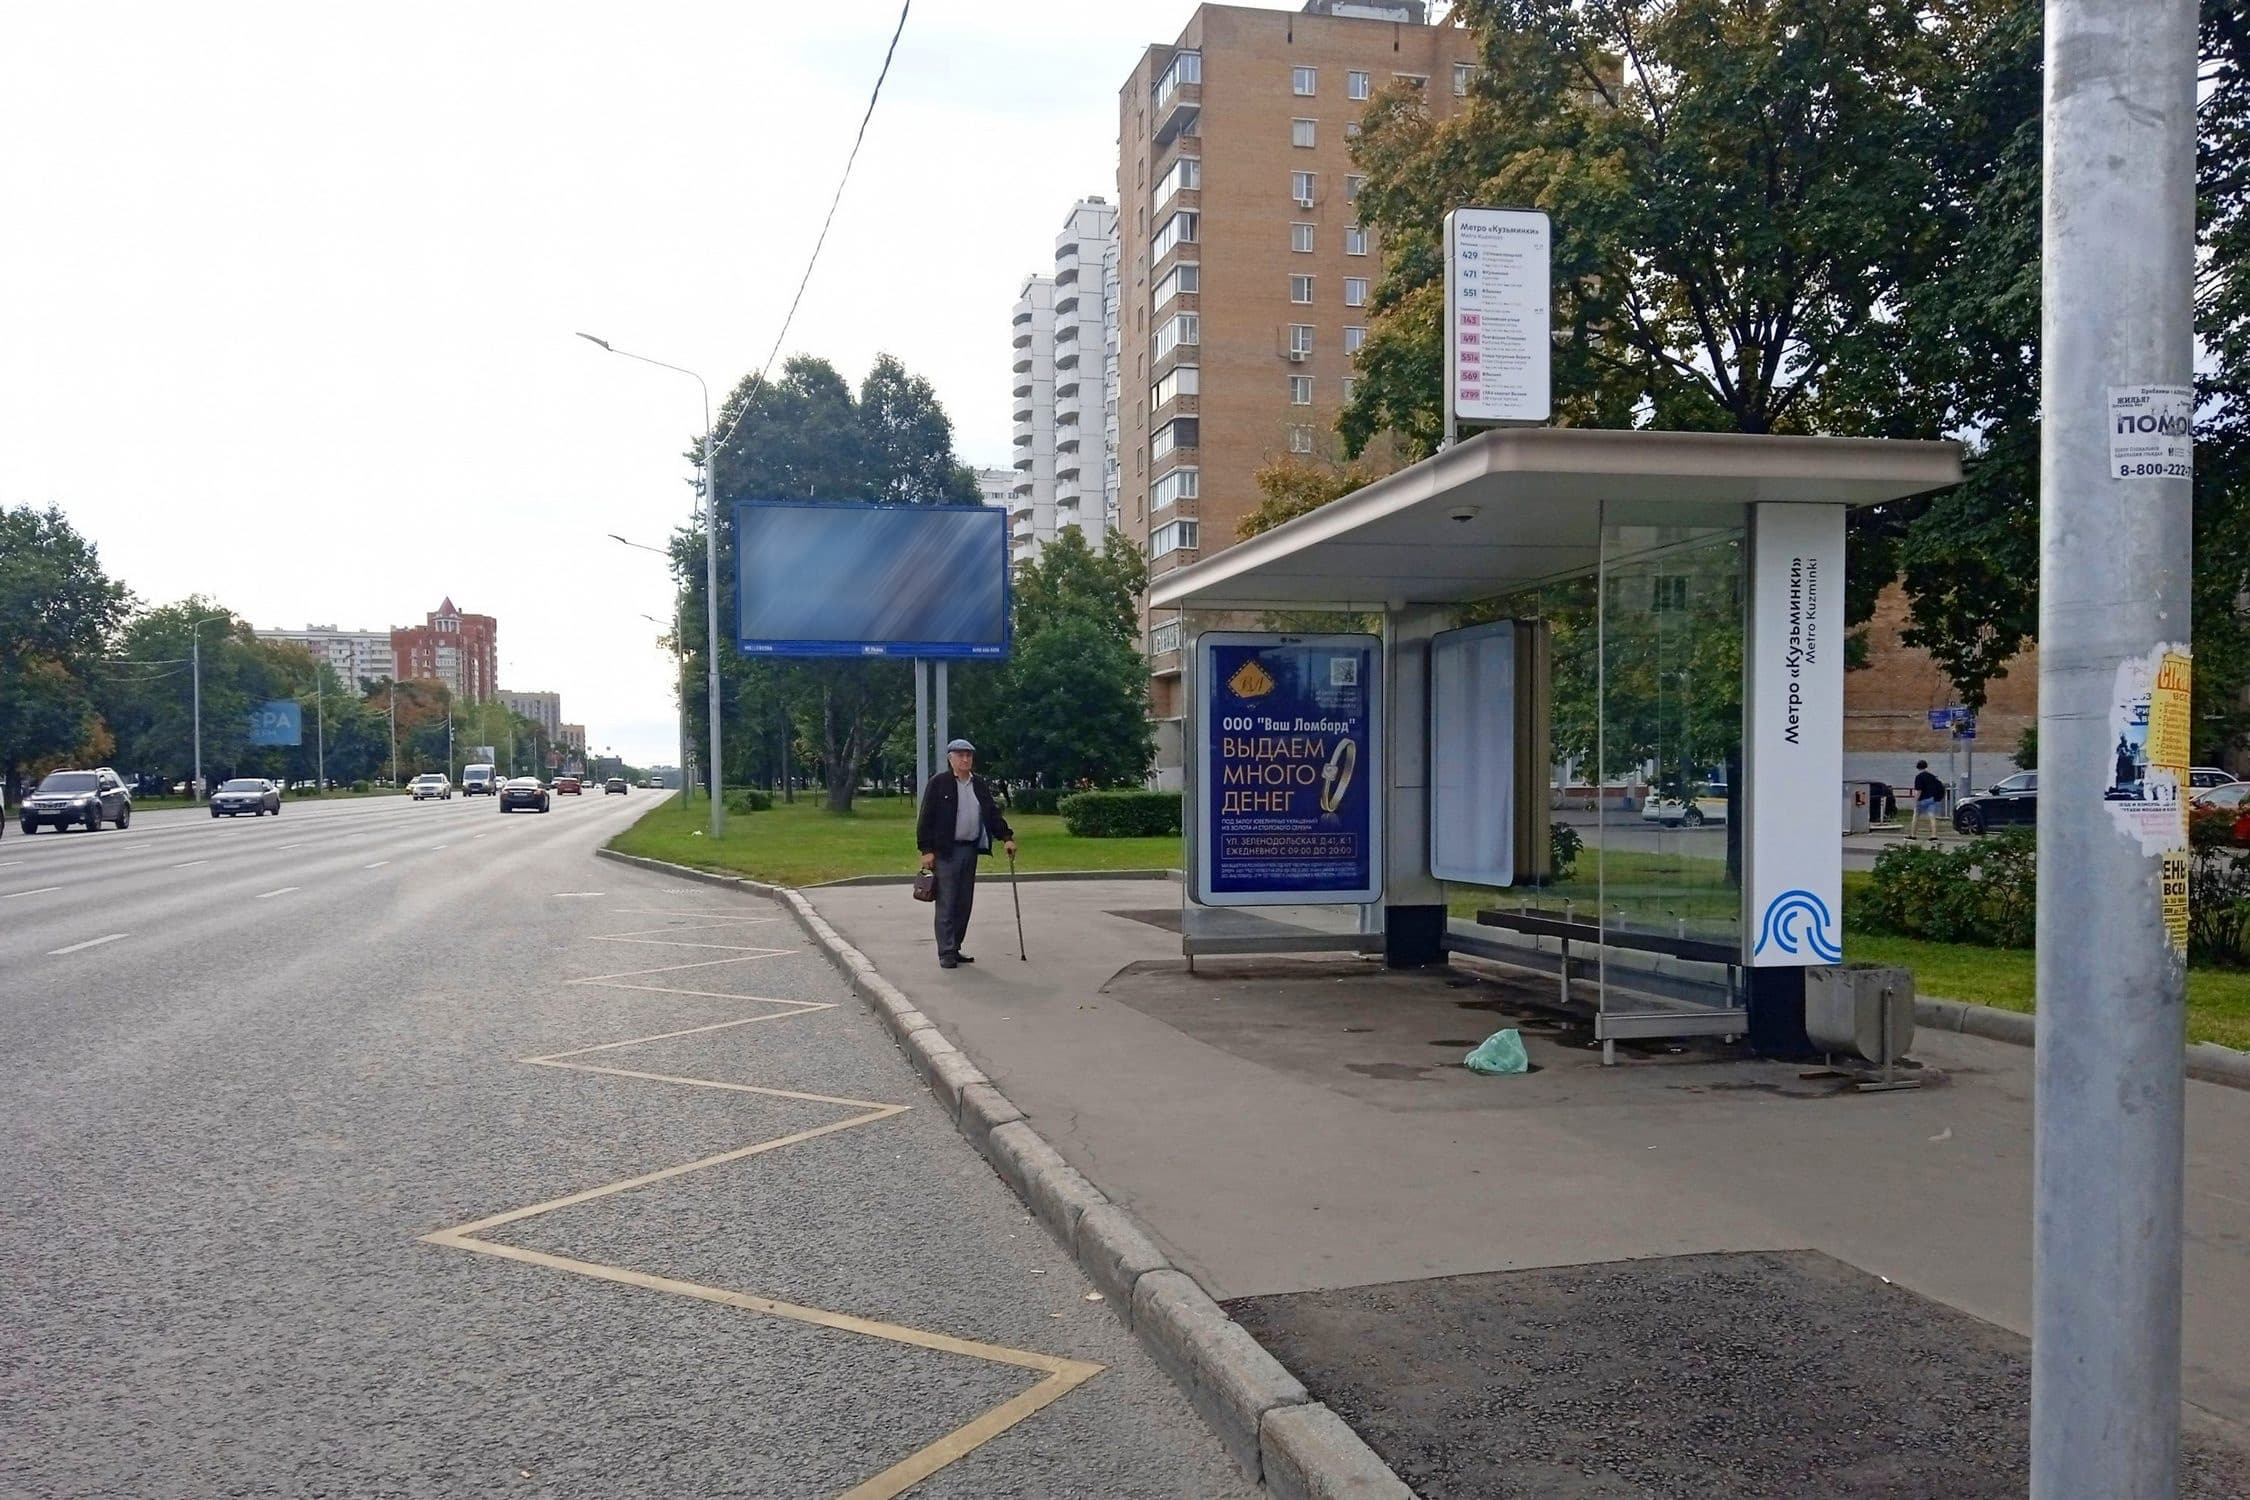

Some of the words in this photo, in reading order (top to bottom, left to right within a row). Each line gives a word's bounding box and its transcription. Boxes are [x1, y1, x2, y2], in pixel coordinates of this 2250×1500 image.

[1460, 223, 1487, 232] Метро
[1462, 250, 1478, 260] 429
[1463, 269, 1477, 279] 471
[1463, 288, 1477, 297] 551
[1463, 316, 1477, 325] 143
[1463, 335, 1477, 343] 491
[1462, 371, 1478, 380] 569
[1806, 558, 1818, 620] Kuzminki
[1786, 557, 1804, 678] «Кузьминки»
[1806, 623, 1817, 665] Metro
[1785, 682, 1803, 744] Метро
[1223, 717, 1253, 731] ООО
[1257, 717, 1290, 731] "Ваш
[1293, 717, 1356, 735] Ломбард"
[1223, 737, 1325, 761] ВЫДАЕМ
[1223, 764, 1316, 785] МНОГО
[1221, 791, 1295, 815] ДЕНЕГ
[1226, 847, 1278, 856] ЕЖЕДНЕВНО
[1280, 847, 1286, 855] С
[1313, 847, 1327, 855] ДО
